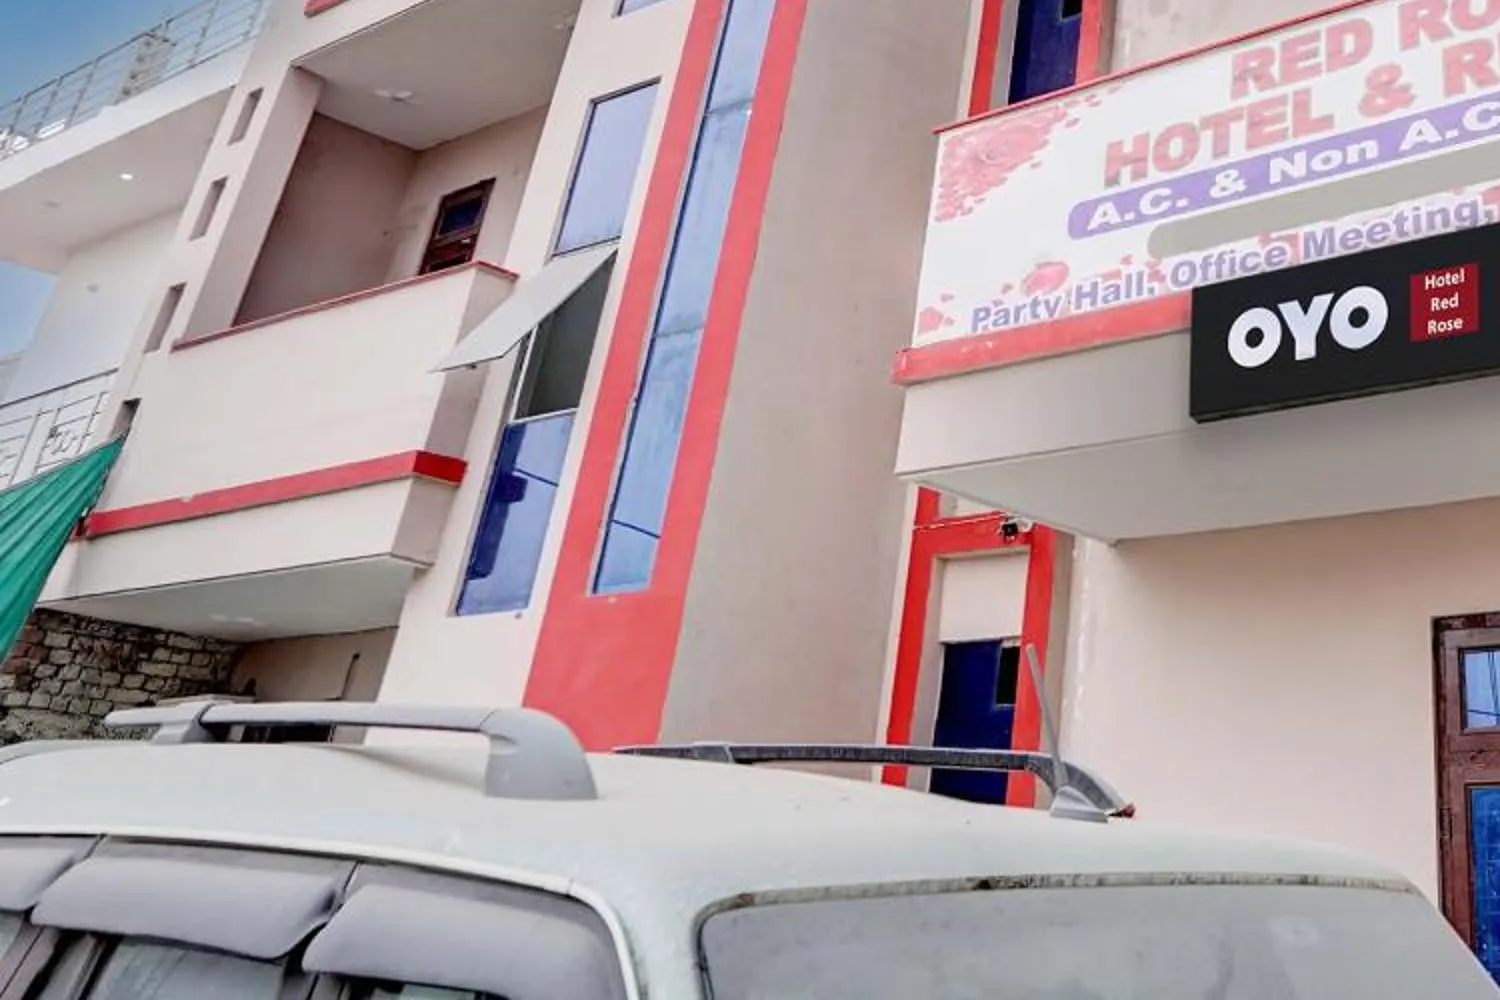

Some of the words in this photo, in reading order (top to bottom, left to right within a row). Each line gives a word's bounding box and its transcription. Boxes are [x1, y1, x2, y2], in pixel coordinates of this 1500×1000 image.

[1230, 17, 1374, 101] RED
[1103, 87, 1335, 189] HOTEL
[1358, 62, 1417, 118] &
[1087, 187, 1189, 231] A.C.
[1209, 168, 1248, 199] &
[1268, 137, 1379, 184] Non
[971, 294, 1062, 333] Party
[1170, 242, 1288, 290] Office
[1424, 268, 1465, 290] Hotel
[1430, 294, 1459, 312] Red
[1227, 285, 1389, 368] OYO
[1427, 316, 1464, 335] Rose
